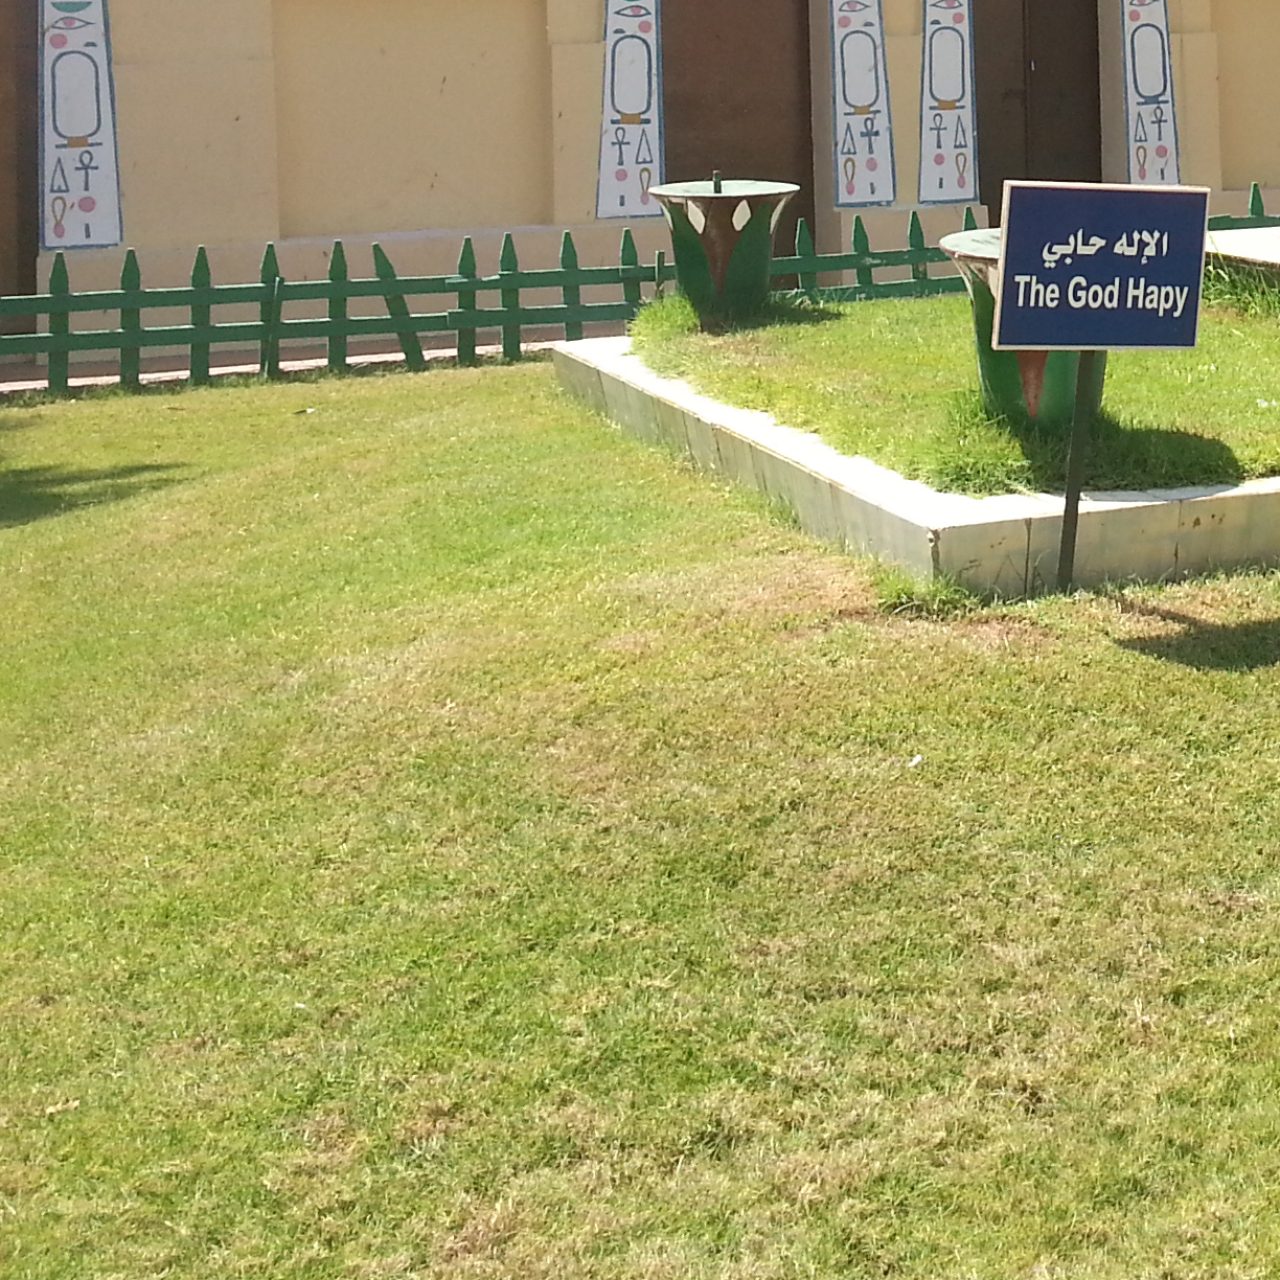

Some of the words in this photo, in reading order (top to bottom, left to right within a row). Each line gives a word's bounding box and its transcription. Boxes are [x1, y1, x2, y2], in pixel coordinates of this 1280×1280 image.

[1042, 228, 1107, 269] حابي
[1112, 229, 1169, 265] الإله
[1014, 275, 1060, 308] The
[1067, 275, 1120, 309] God
[1126, 276, 1189, 318] Hapy
